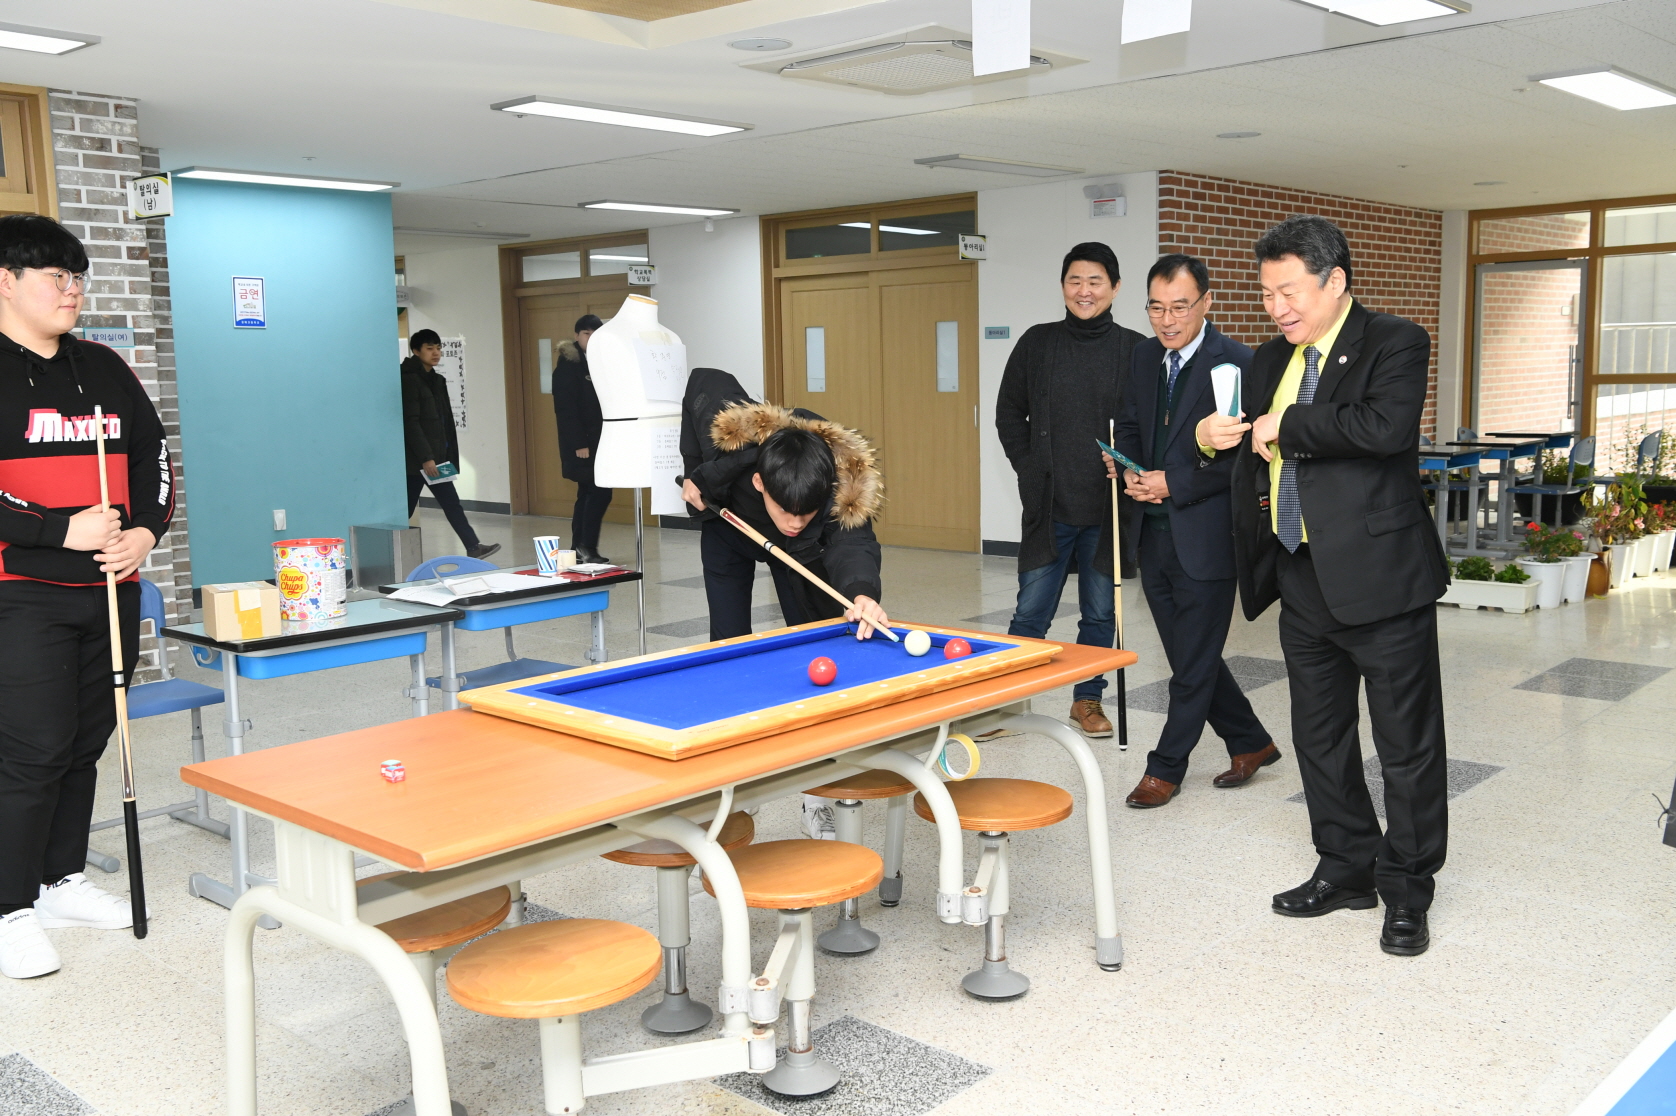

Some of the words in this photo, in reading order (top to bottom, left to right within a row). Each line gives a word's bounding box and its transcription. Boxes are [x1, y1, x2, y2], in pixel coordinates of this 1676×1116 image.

[139, 181, 159, 197] 탈의실
[143, 197, 157, 211] (남)
[239, 288, 259, 300] 금연
[91, 333, 128, 341] 탈의실(여)
[280, 573, 304, 584] Chupa
[280, 582, 303, 593] Chups
[46, 878, 71, 891] FILA
